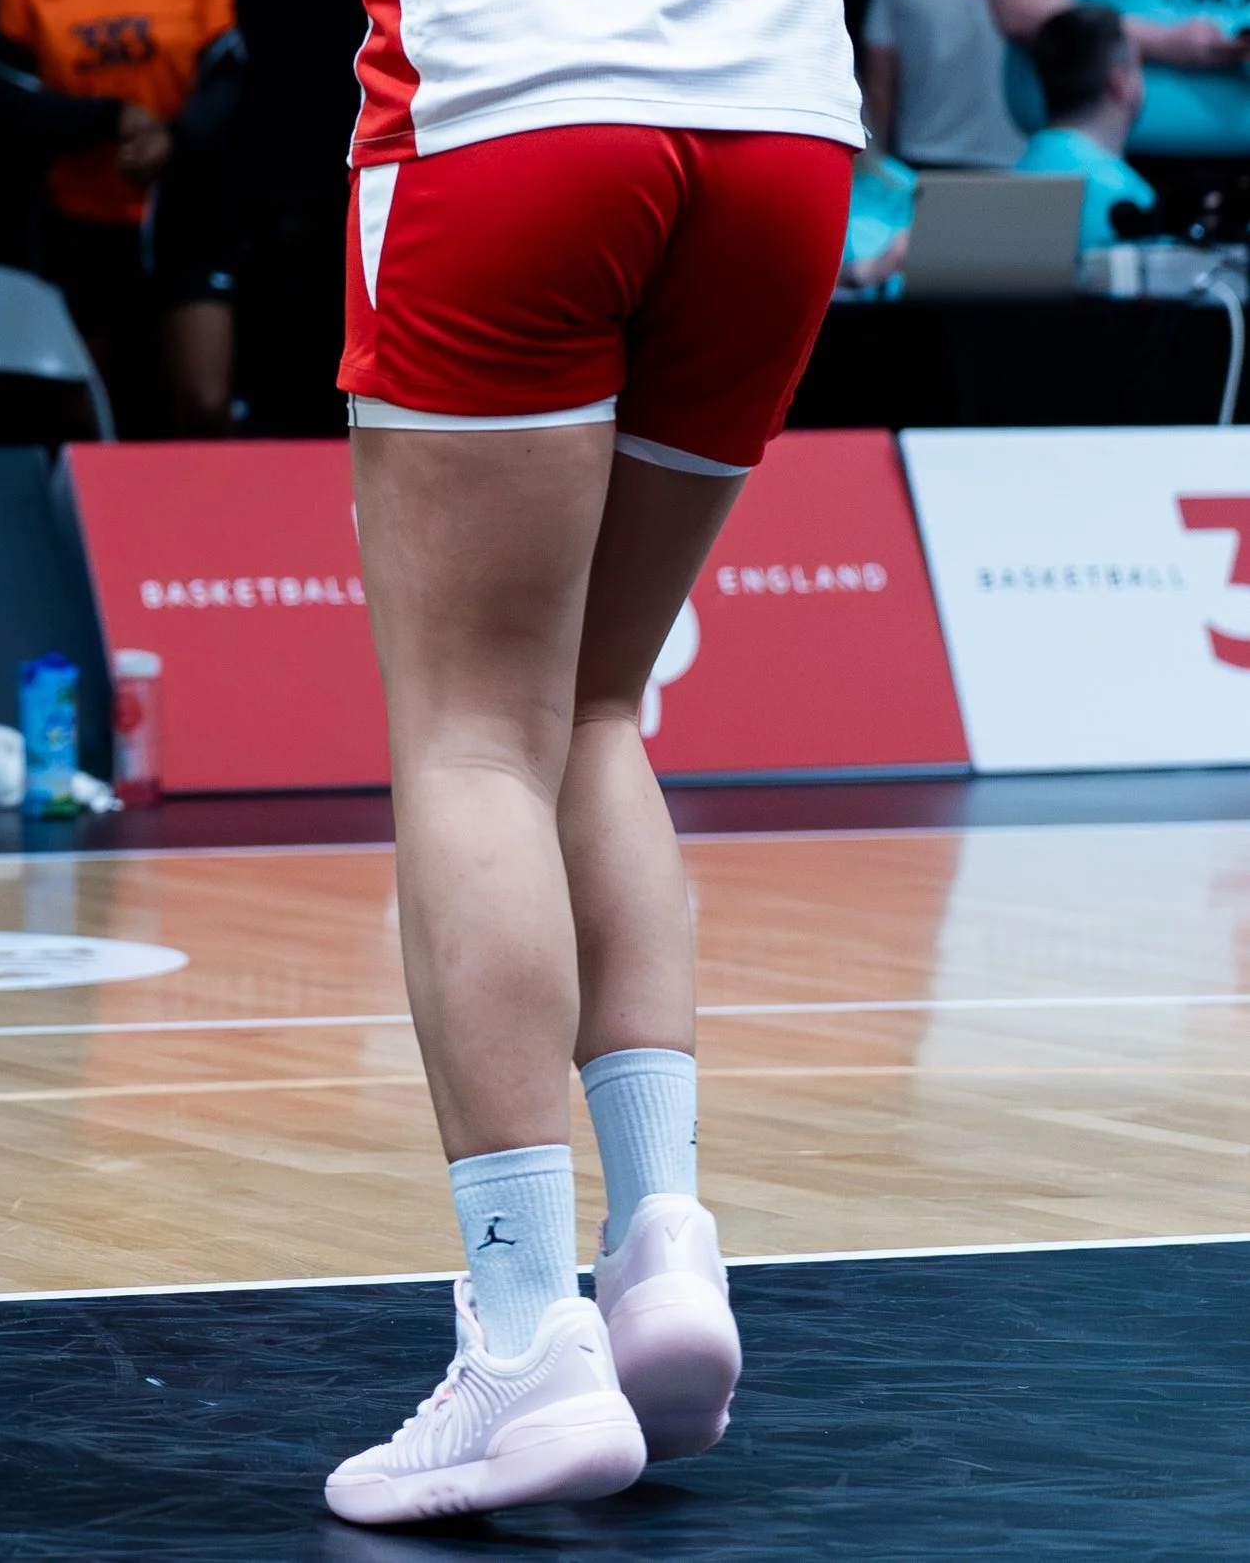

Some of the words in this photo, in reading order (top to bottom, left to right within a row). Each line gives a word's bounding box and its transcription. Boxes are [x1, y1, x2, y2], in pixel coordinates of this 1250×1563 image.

[140, 576, 367, 609] BASKETBALL
[717, 562, 888, 596] ENGLAND
[979, 564, 1186, 592] BASKETBALL
